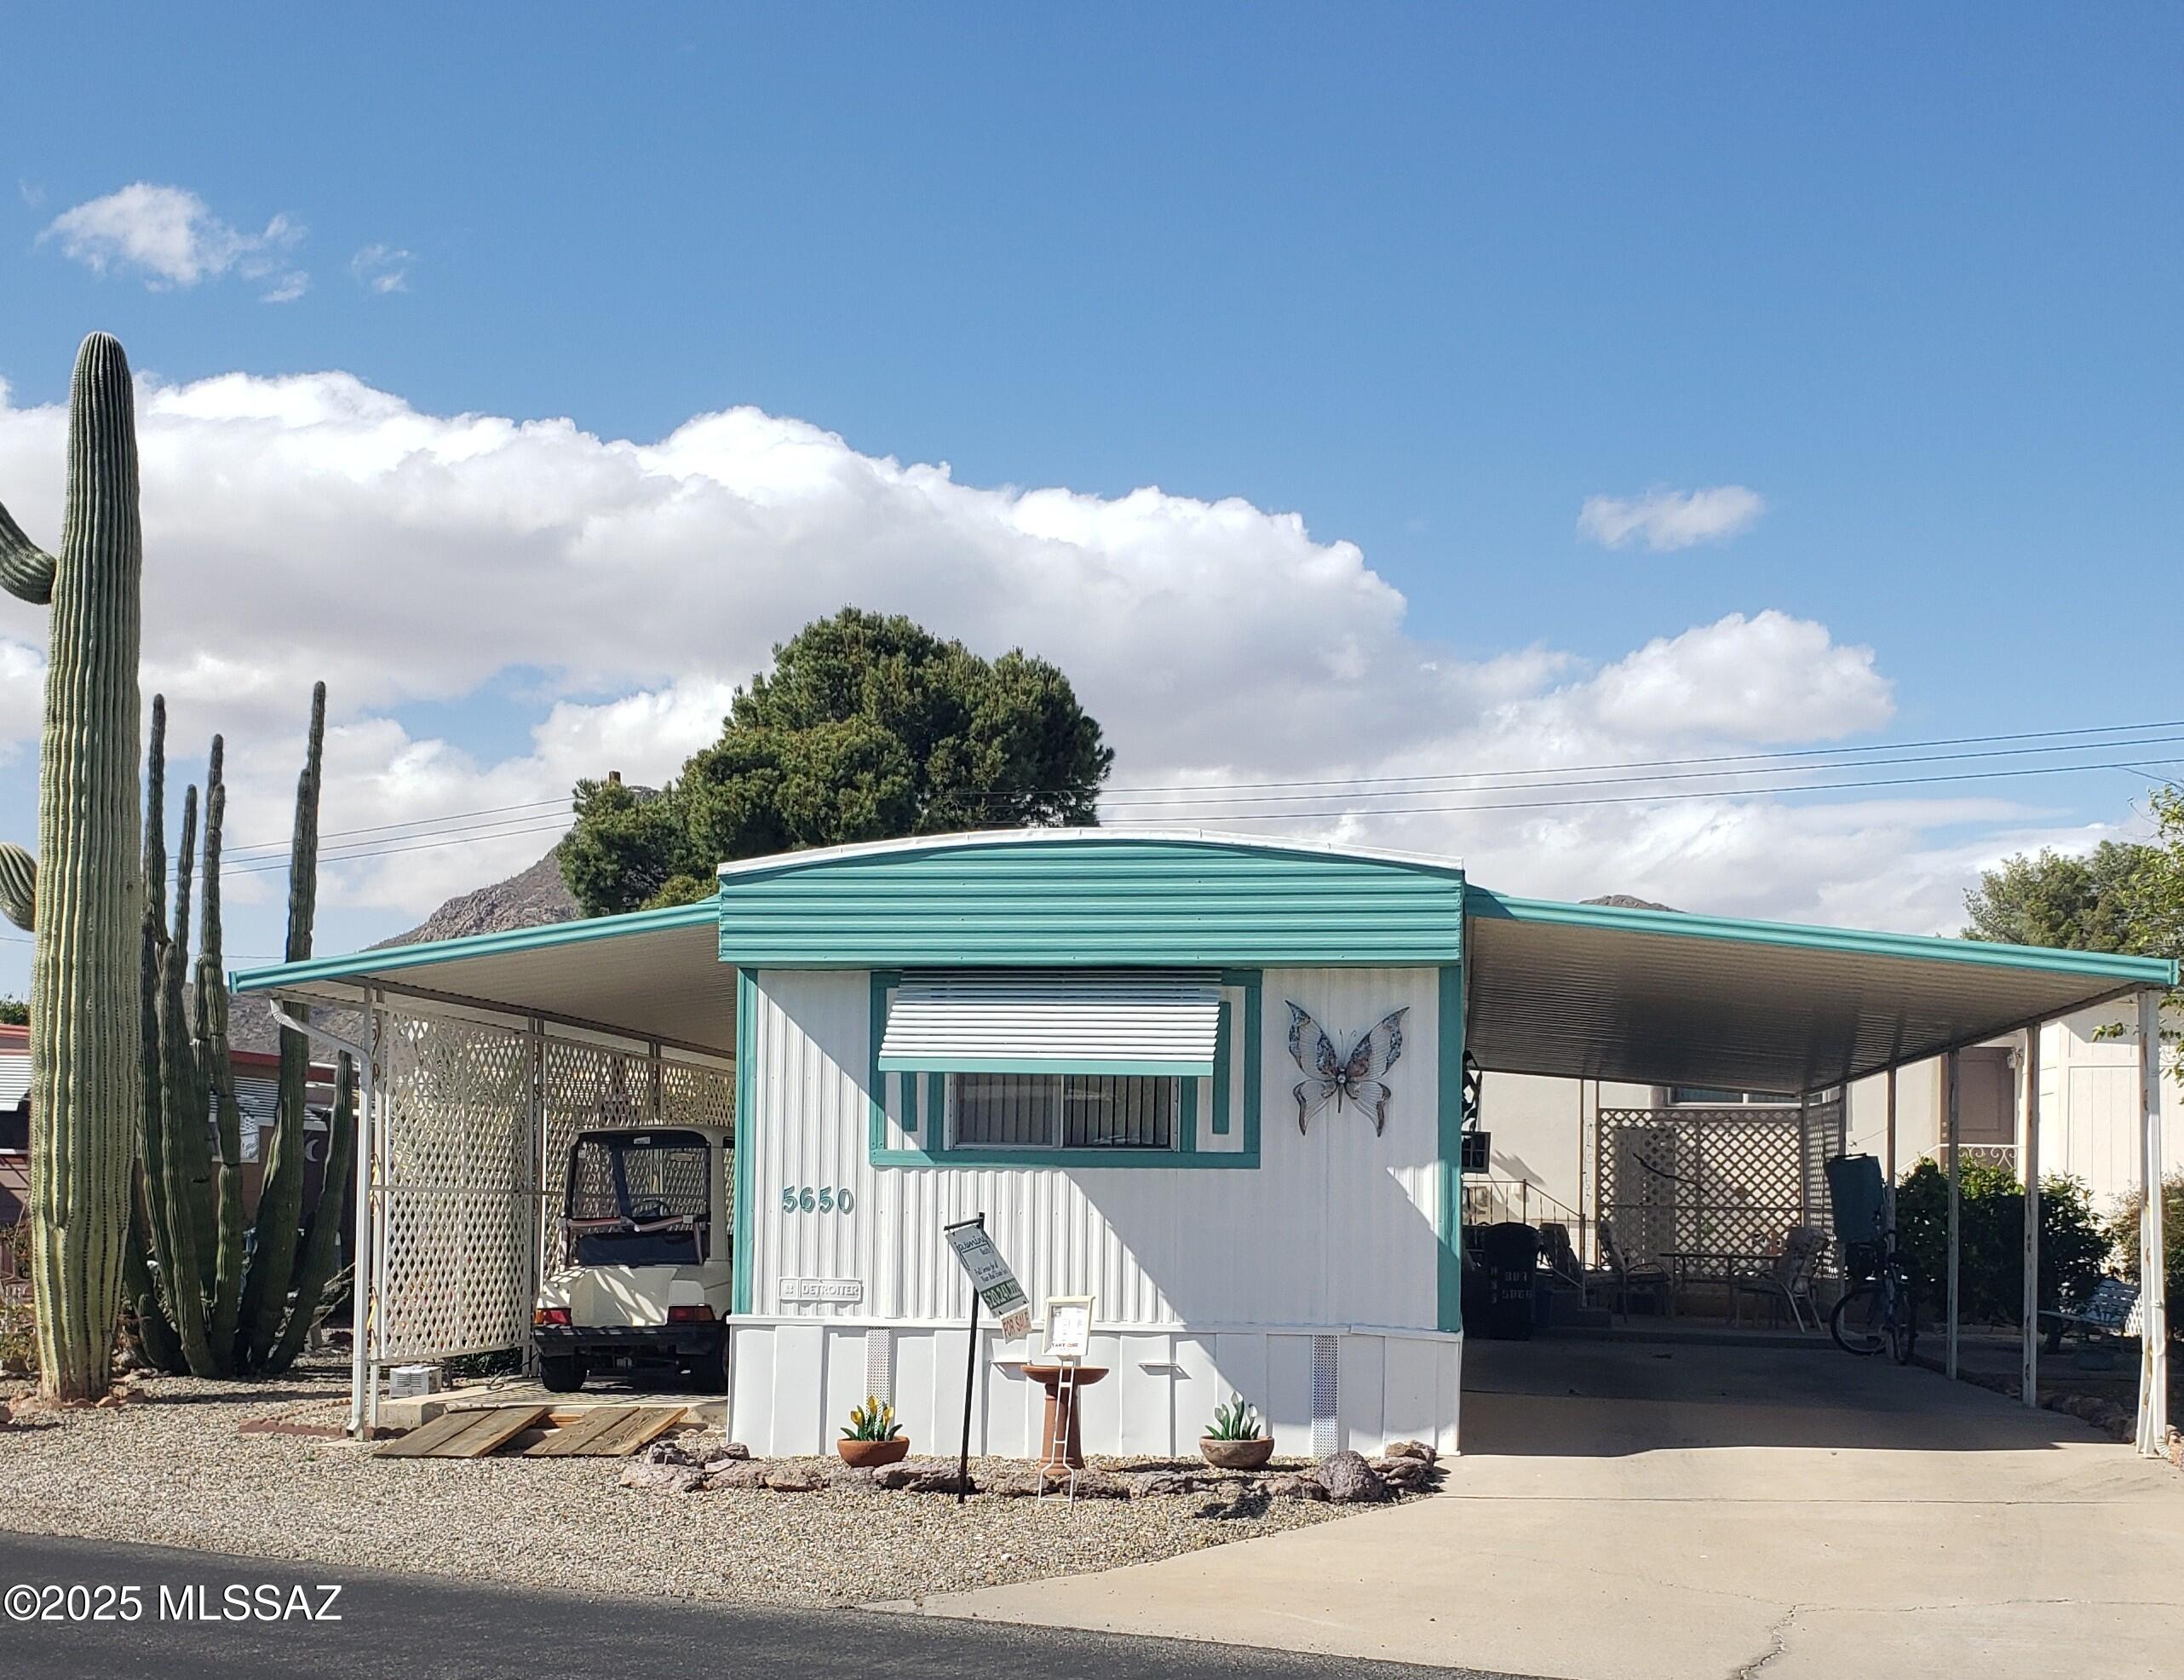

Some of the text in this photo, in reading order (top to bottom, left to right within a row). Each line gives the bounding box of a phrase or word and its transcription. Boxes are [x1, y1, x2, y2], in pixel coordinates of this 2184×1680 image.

[783, 1185, 855, 1215] 5650
[802, 1284, 859, 1296] DETROITER
[1003, 1317, 1015, 1338] FOR
[1015, 1311, 1029, 1332] SALE
